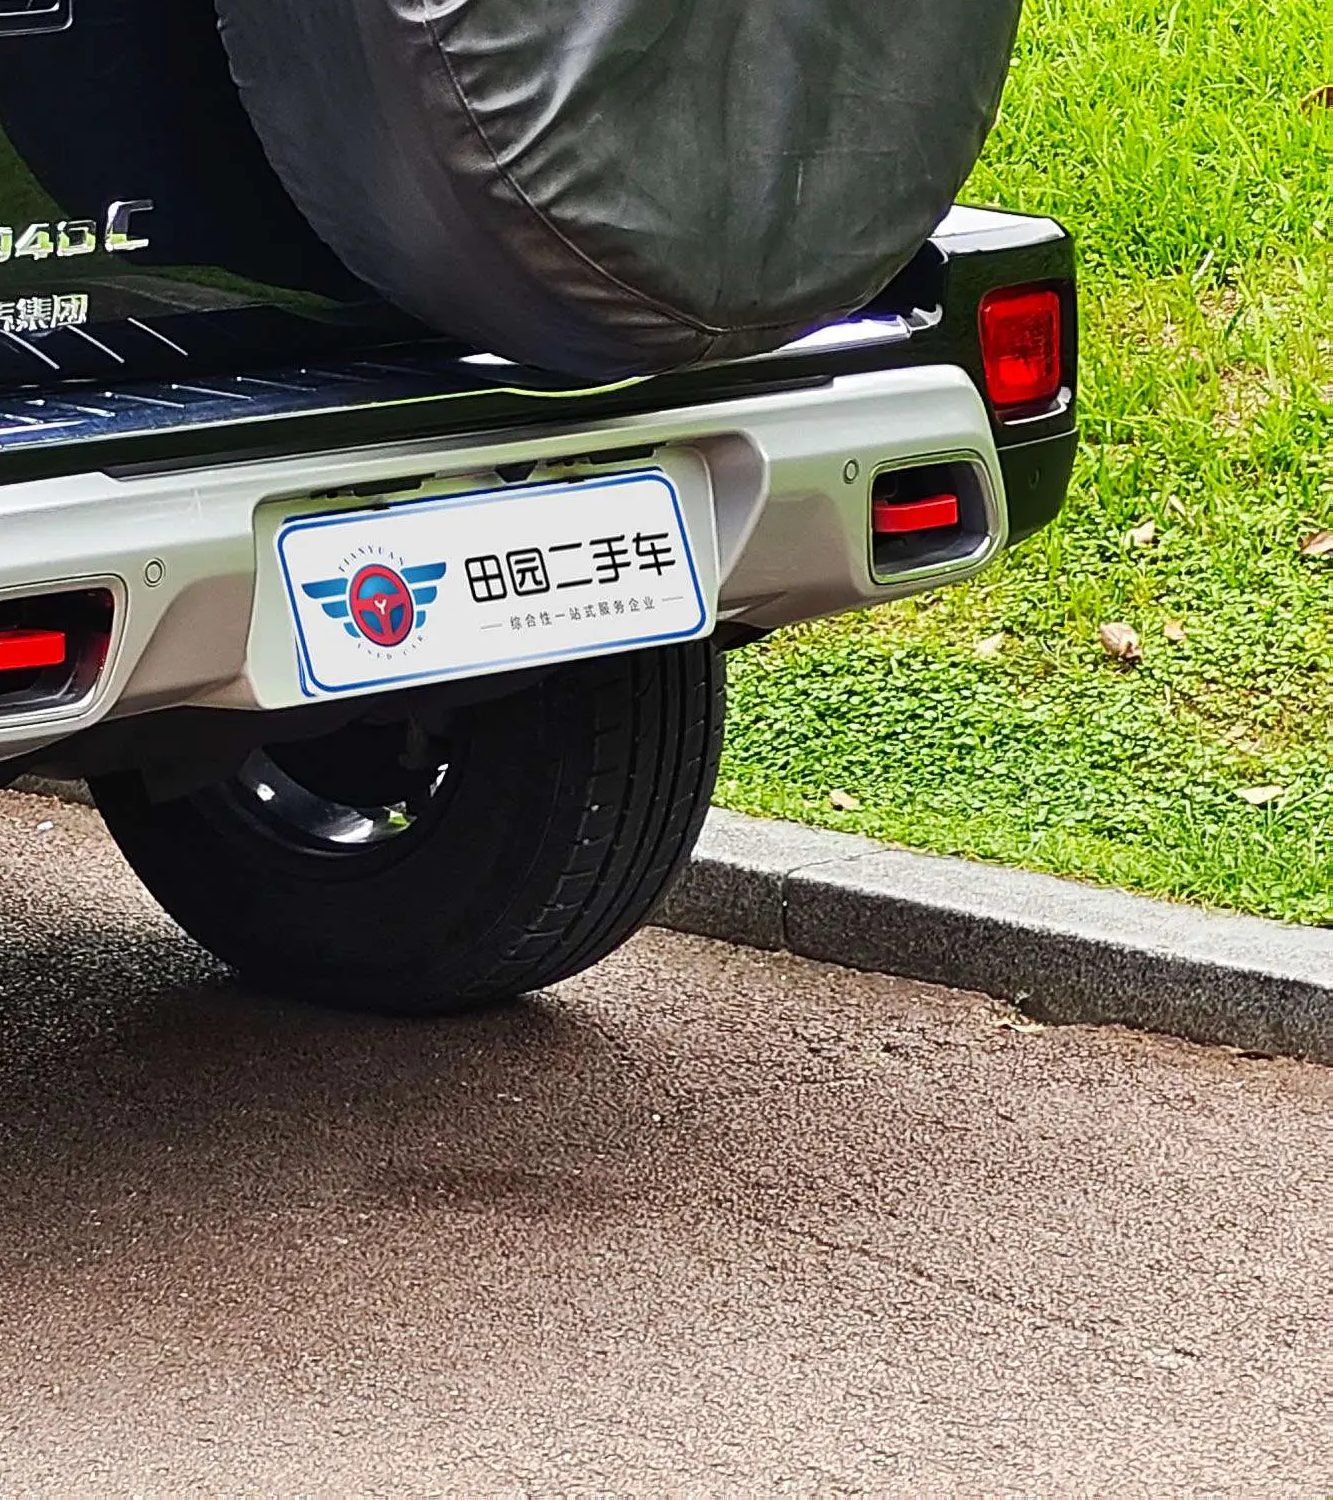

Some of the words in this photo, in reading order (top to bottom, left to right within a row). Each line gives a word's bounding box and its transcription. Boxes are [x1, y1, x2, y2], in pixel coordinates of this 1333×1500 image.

[464, 531, 676, 603] 田园二手车
[509, 596, 655, 631] 综合性一站式服务企业
